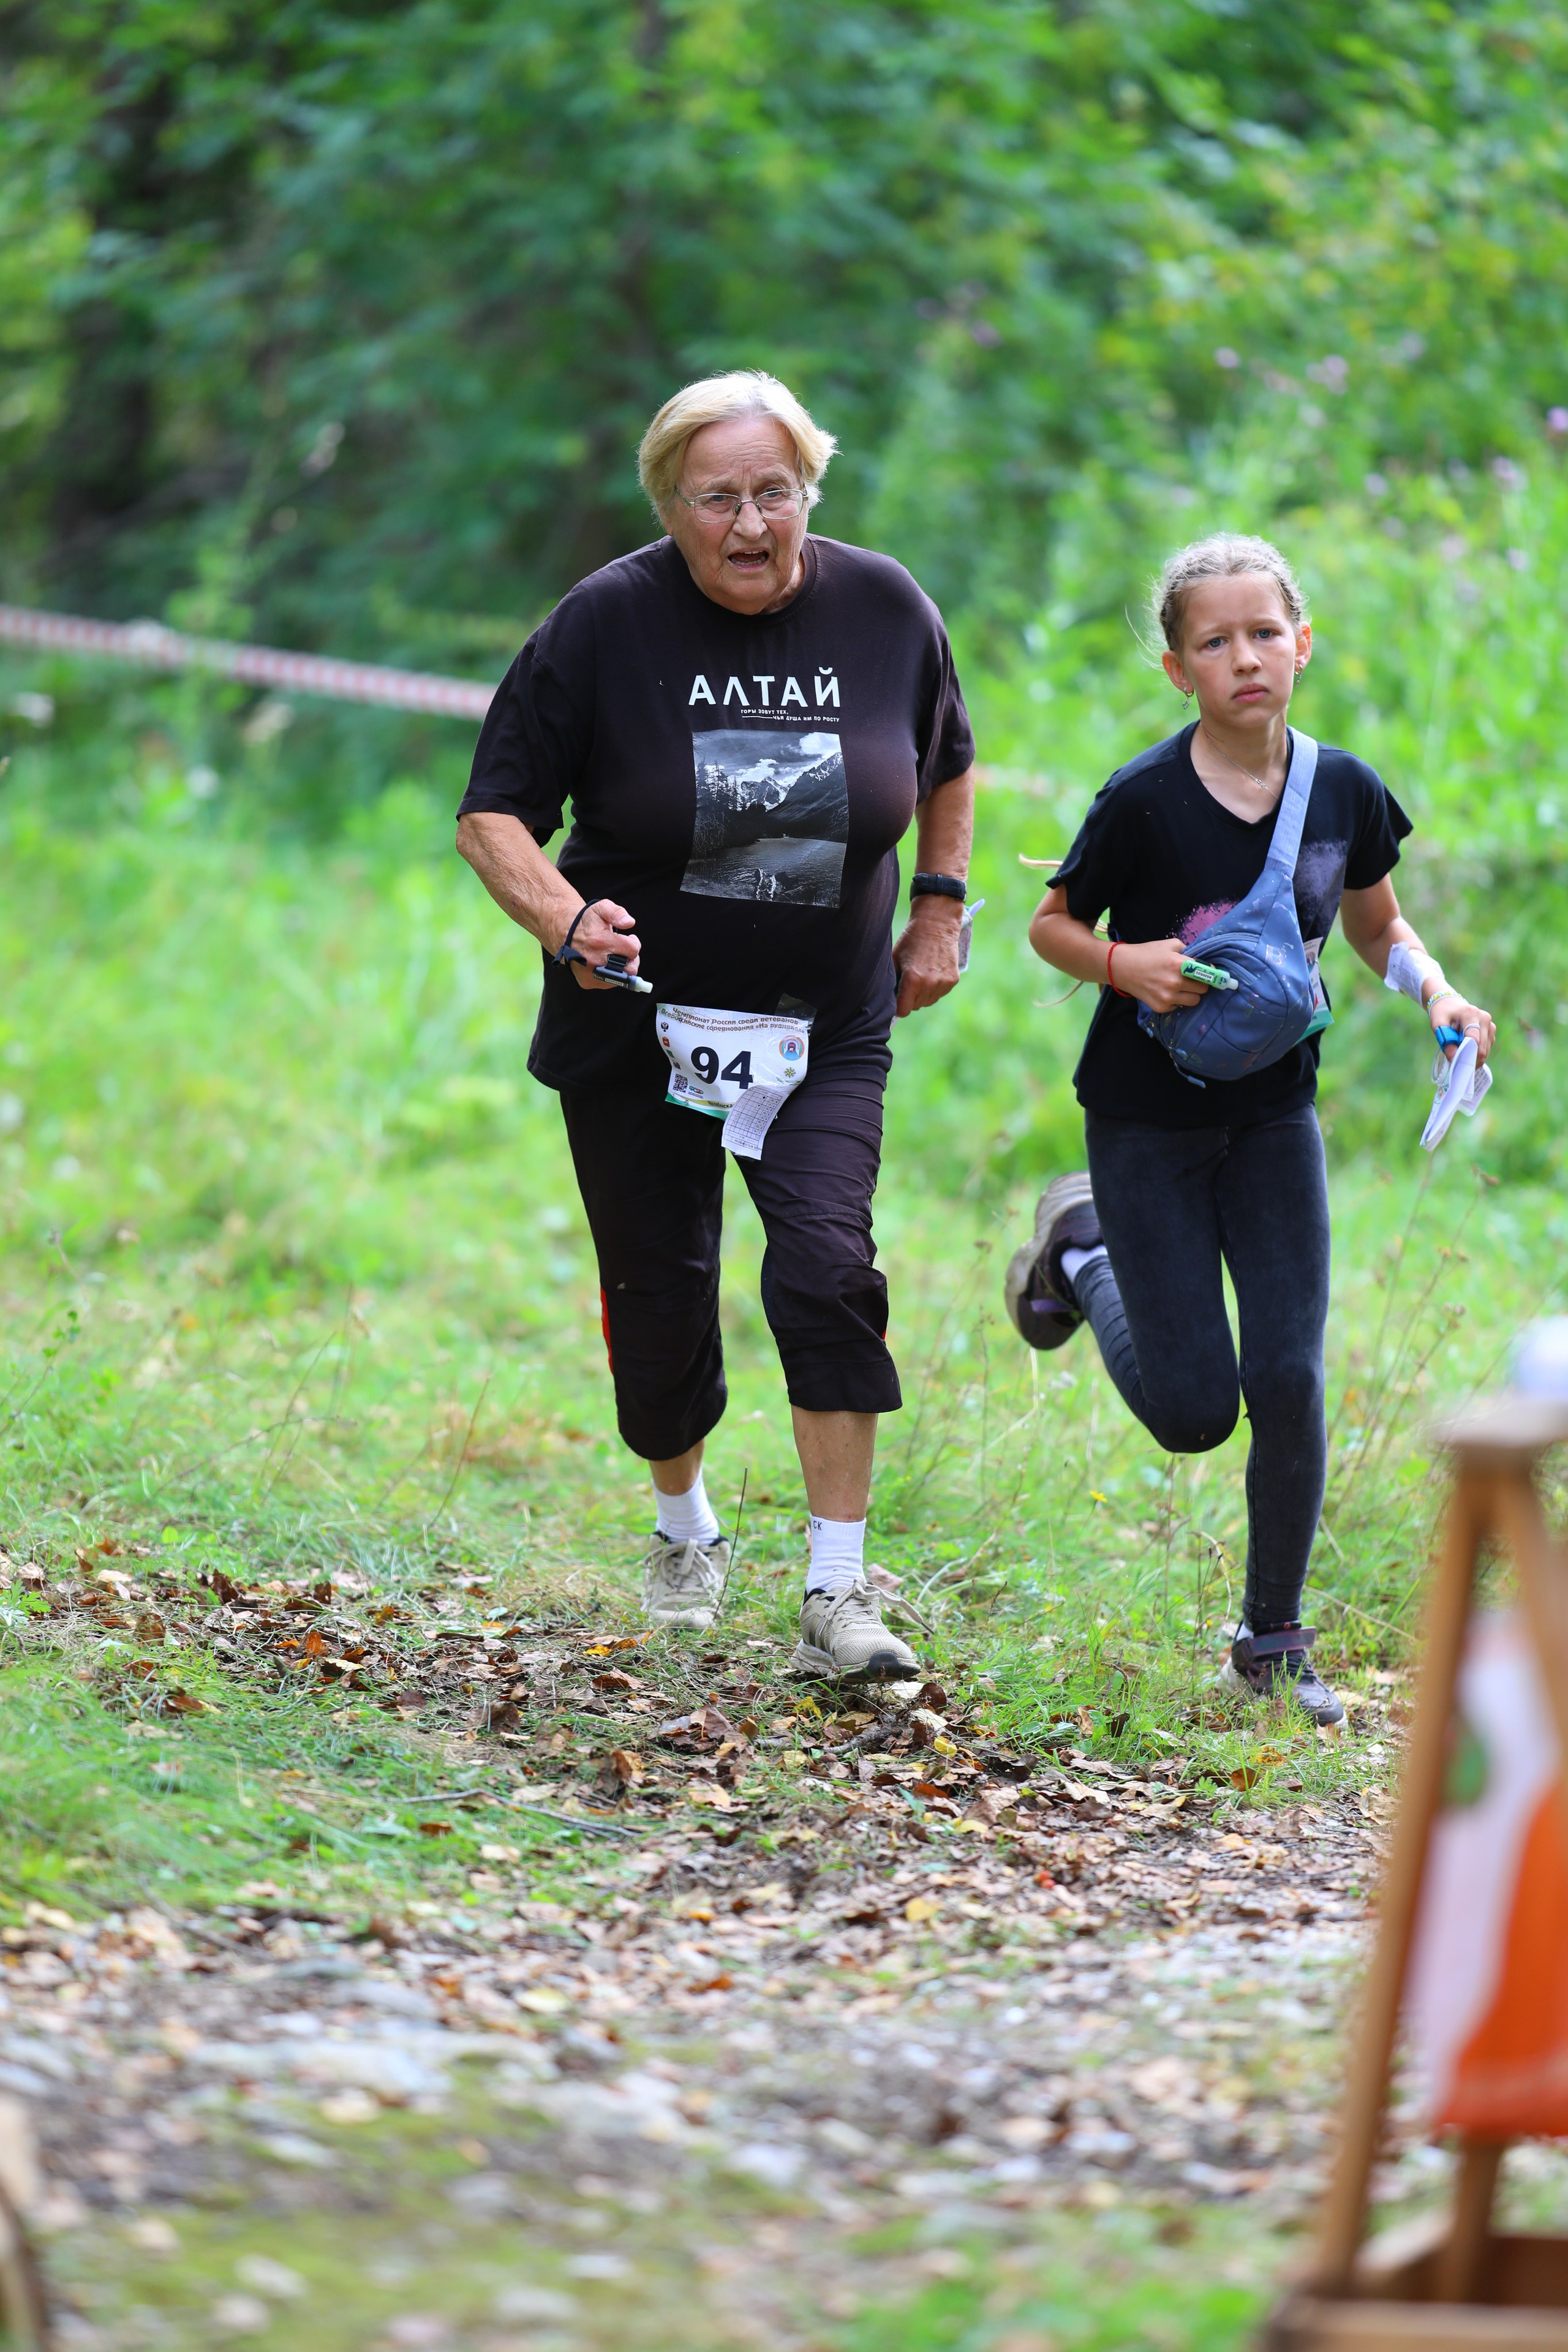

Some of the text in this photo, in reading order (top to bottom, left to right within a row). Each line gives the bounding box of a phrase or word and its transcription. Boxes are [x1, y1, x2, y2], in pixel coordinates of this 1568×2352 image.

[688, 666, 840, 707] АЛТАЙ
[662, 1008, 705, 1029] Всероссийские
[673, 1007, 710, 1024] Чемпионат
[761, 1017, 799, 1025] ветеранов
[691, 1046, 753, 1090] 94
[707, 1100, 736, 1109] Челябинска
